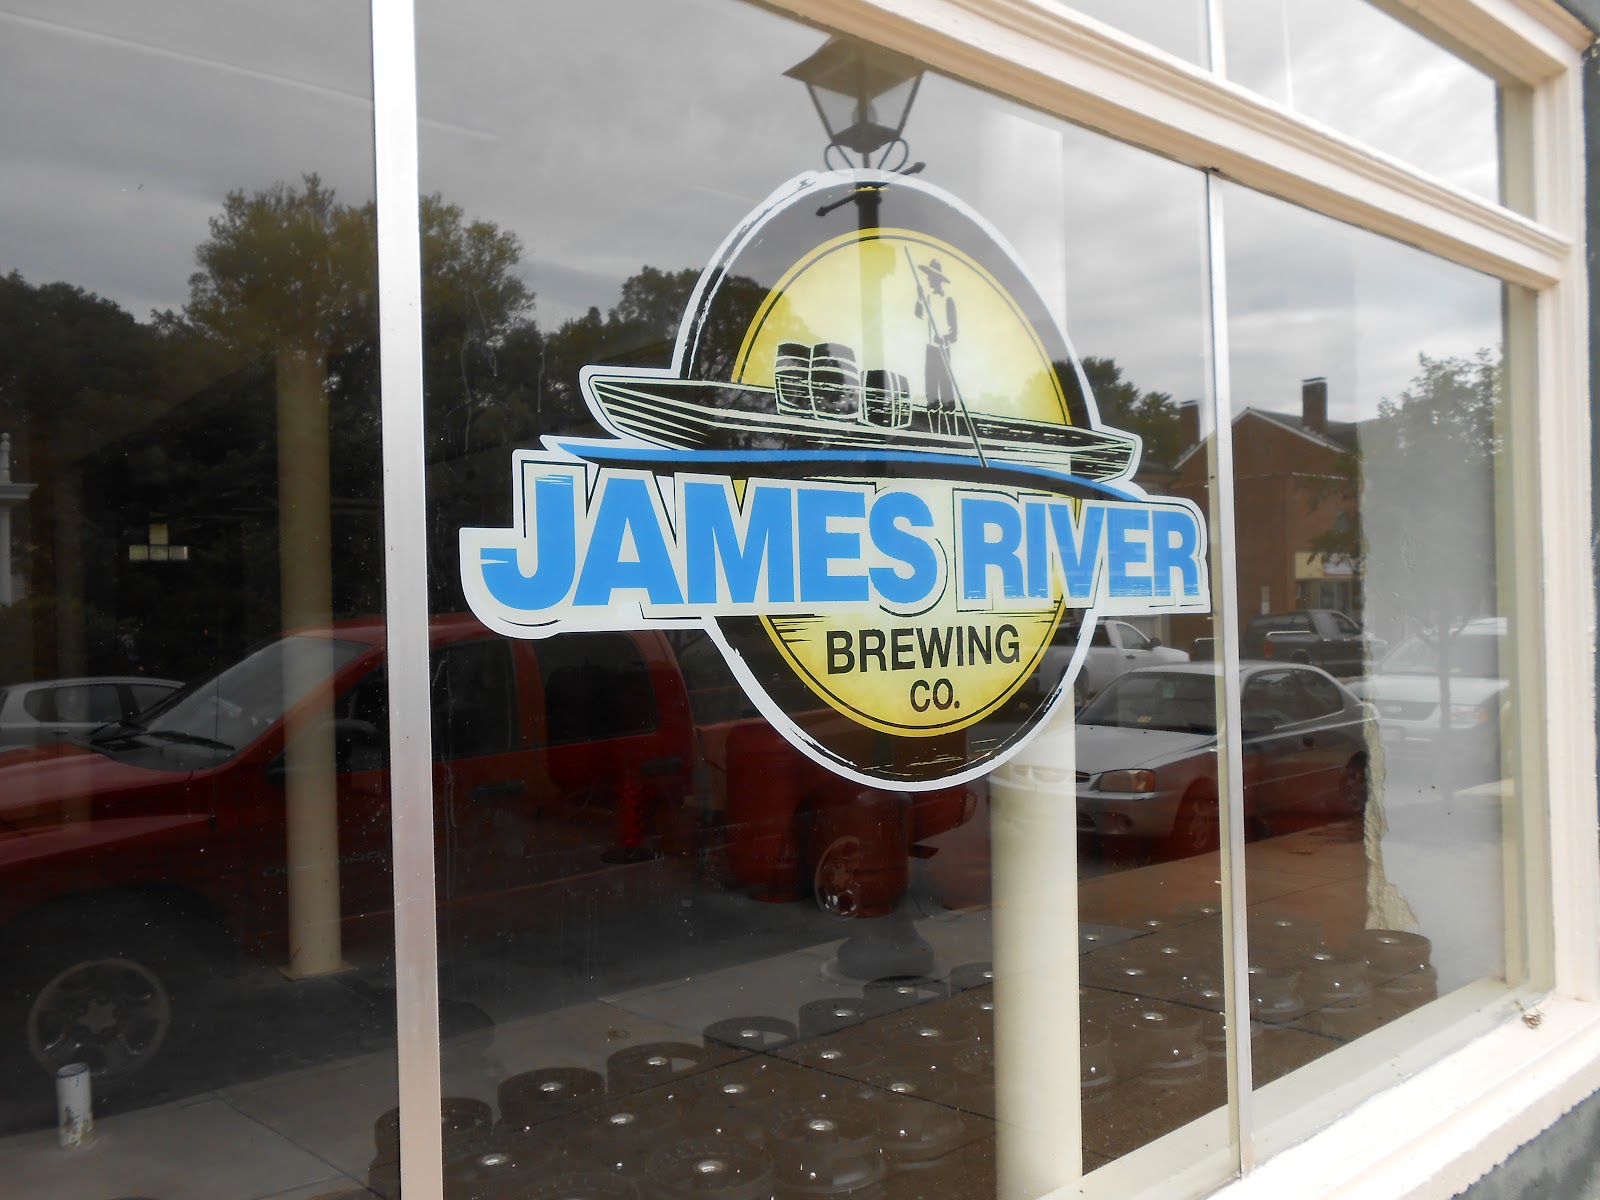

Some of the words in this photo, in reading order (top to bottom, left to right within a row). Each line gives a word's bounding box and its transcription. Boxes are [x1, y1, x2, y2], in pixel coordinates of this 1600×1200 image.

[480, 474, 939, 611] JAMES
[961, 498, 1199, 600] RIVER
[826, 623, 1020, 675] BREWING
[909, 678, 961, 712] CO.
